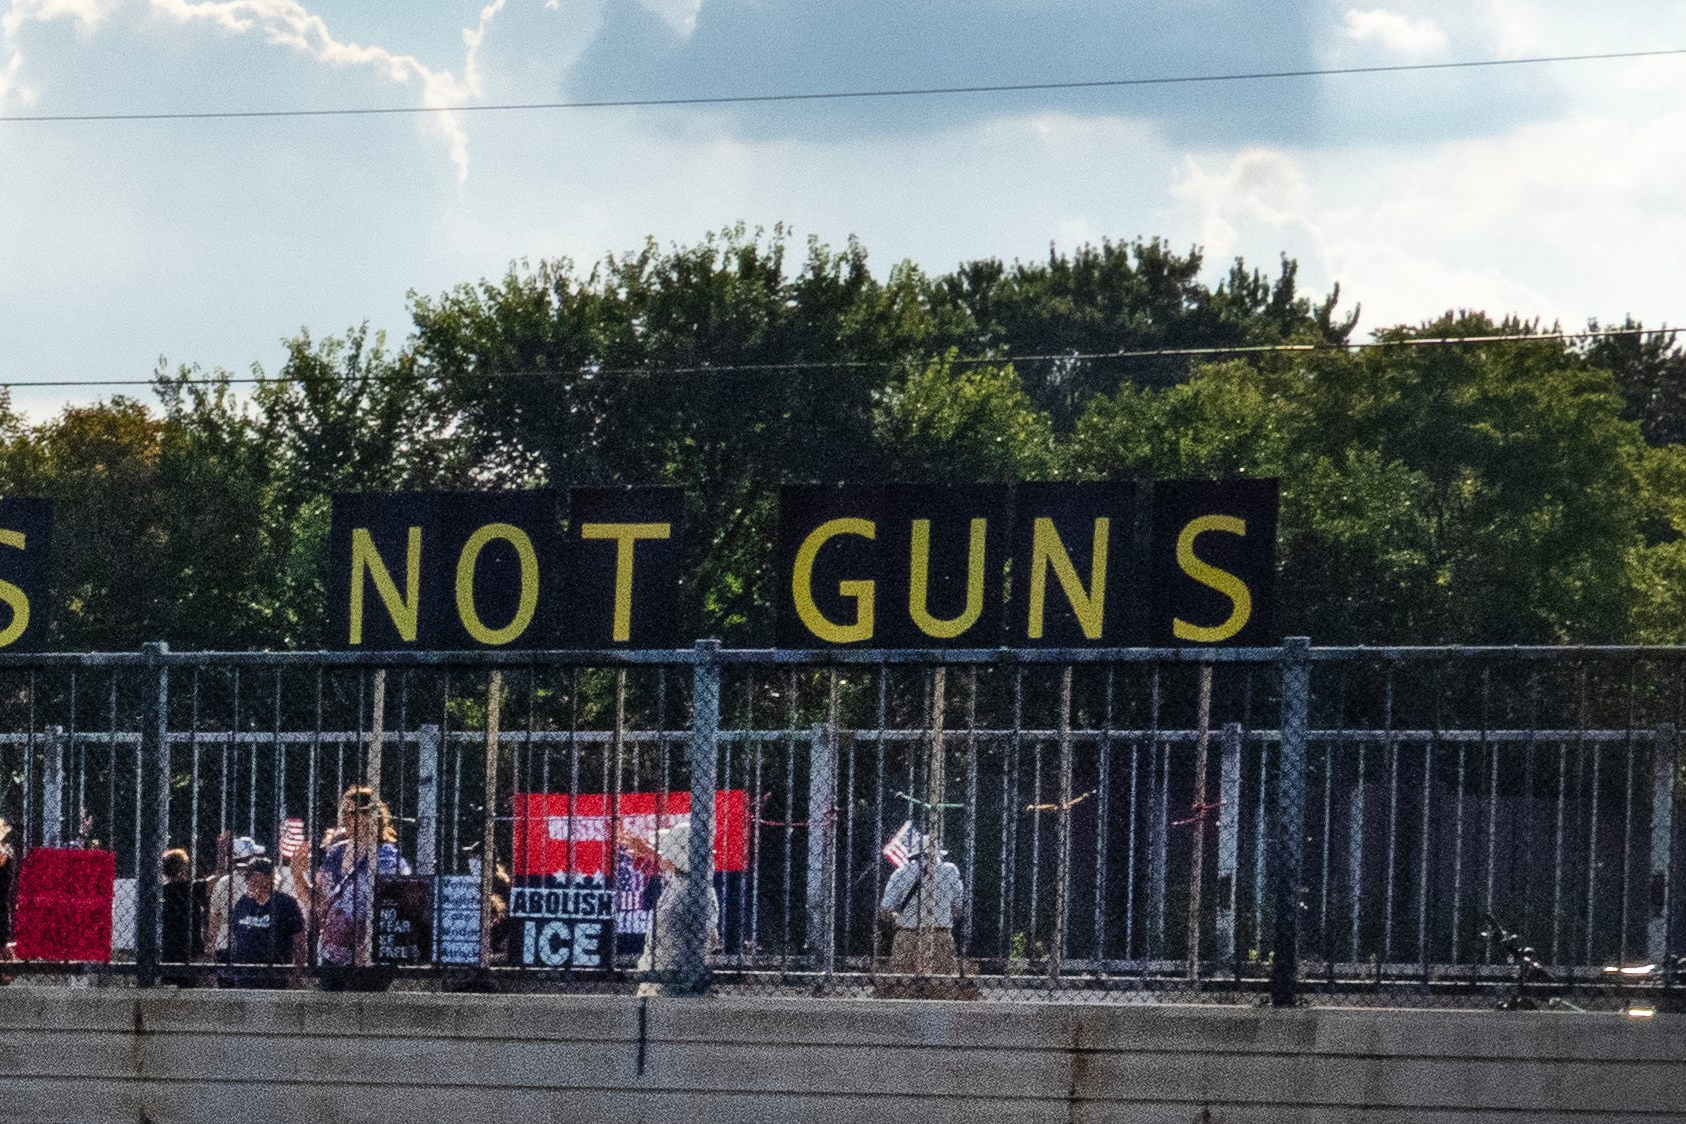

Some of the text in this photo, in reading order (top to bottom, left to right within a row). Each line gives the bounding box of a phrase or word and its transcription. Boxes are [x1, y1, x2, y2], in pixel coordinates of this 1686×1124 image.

[348, 522, 671, 645] NOT
[791, 513, 1253, 643] GUNS
[513, 891, 613, 915] ABOLISH
[522, 920, 602, 967] ICE
